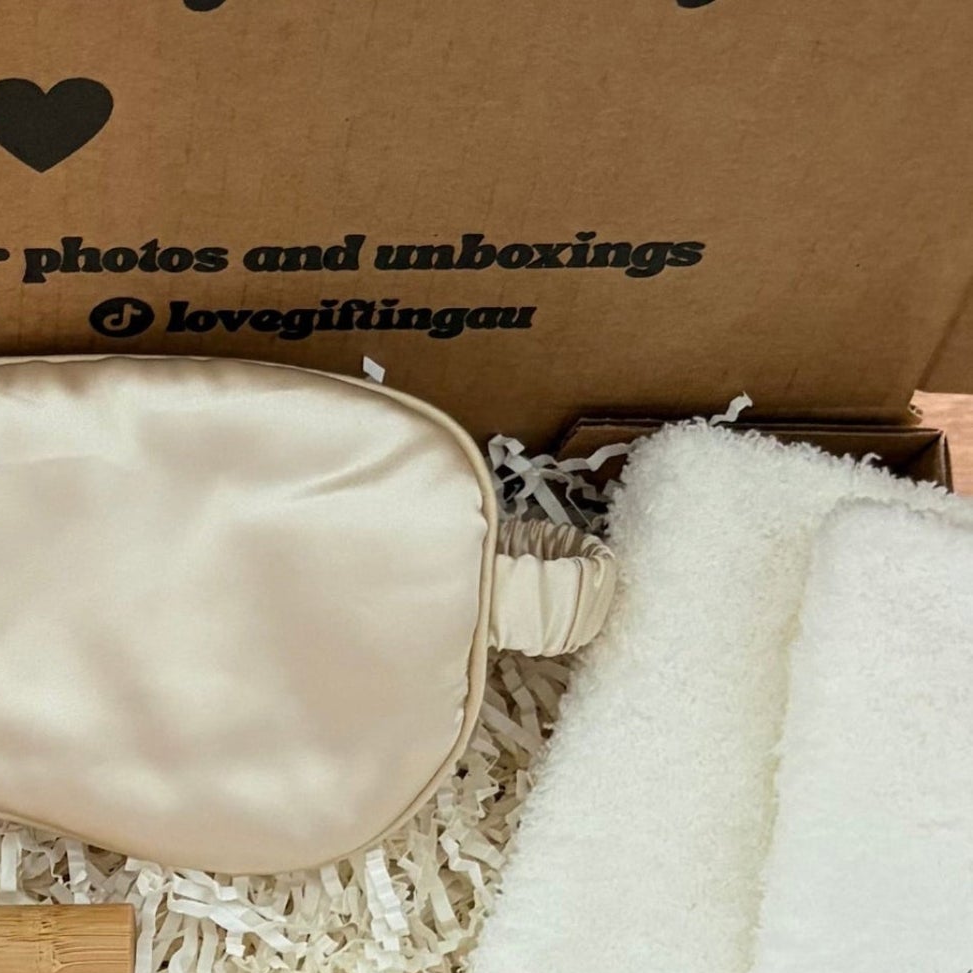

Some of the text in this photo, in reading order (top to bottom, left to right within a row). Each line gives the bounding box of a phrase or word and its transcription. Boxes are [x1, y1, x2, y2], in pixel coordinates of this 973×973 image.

[22, 236, 229, 284] photos
[243, 233, 366, 273] and
[374, 230, 706, 278] unboxings
[166, 298, 537, 339] lovegiftingau
